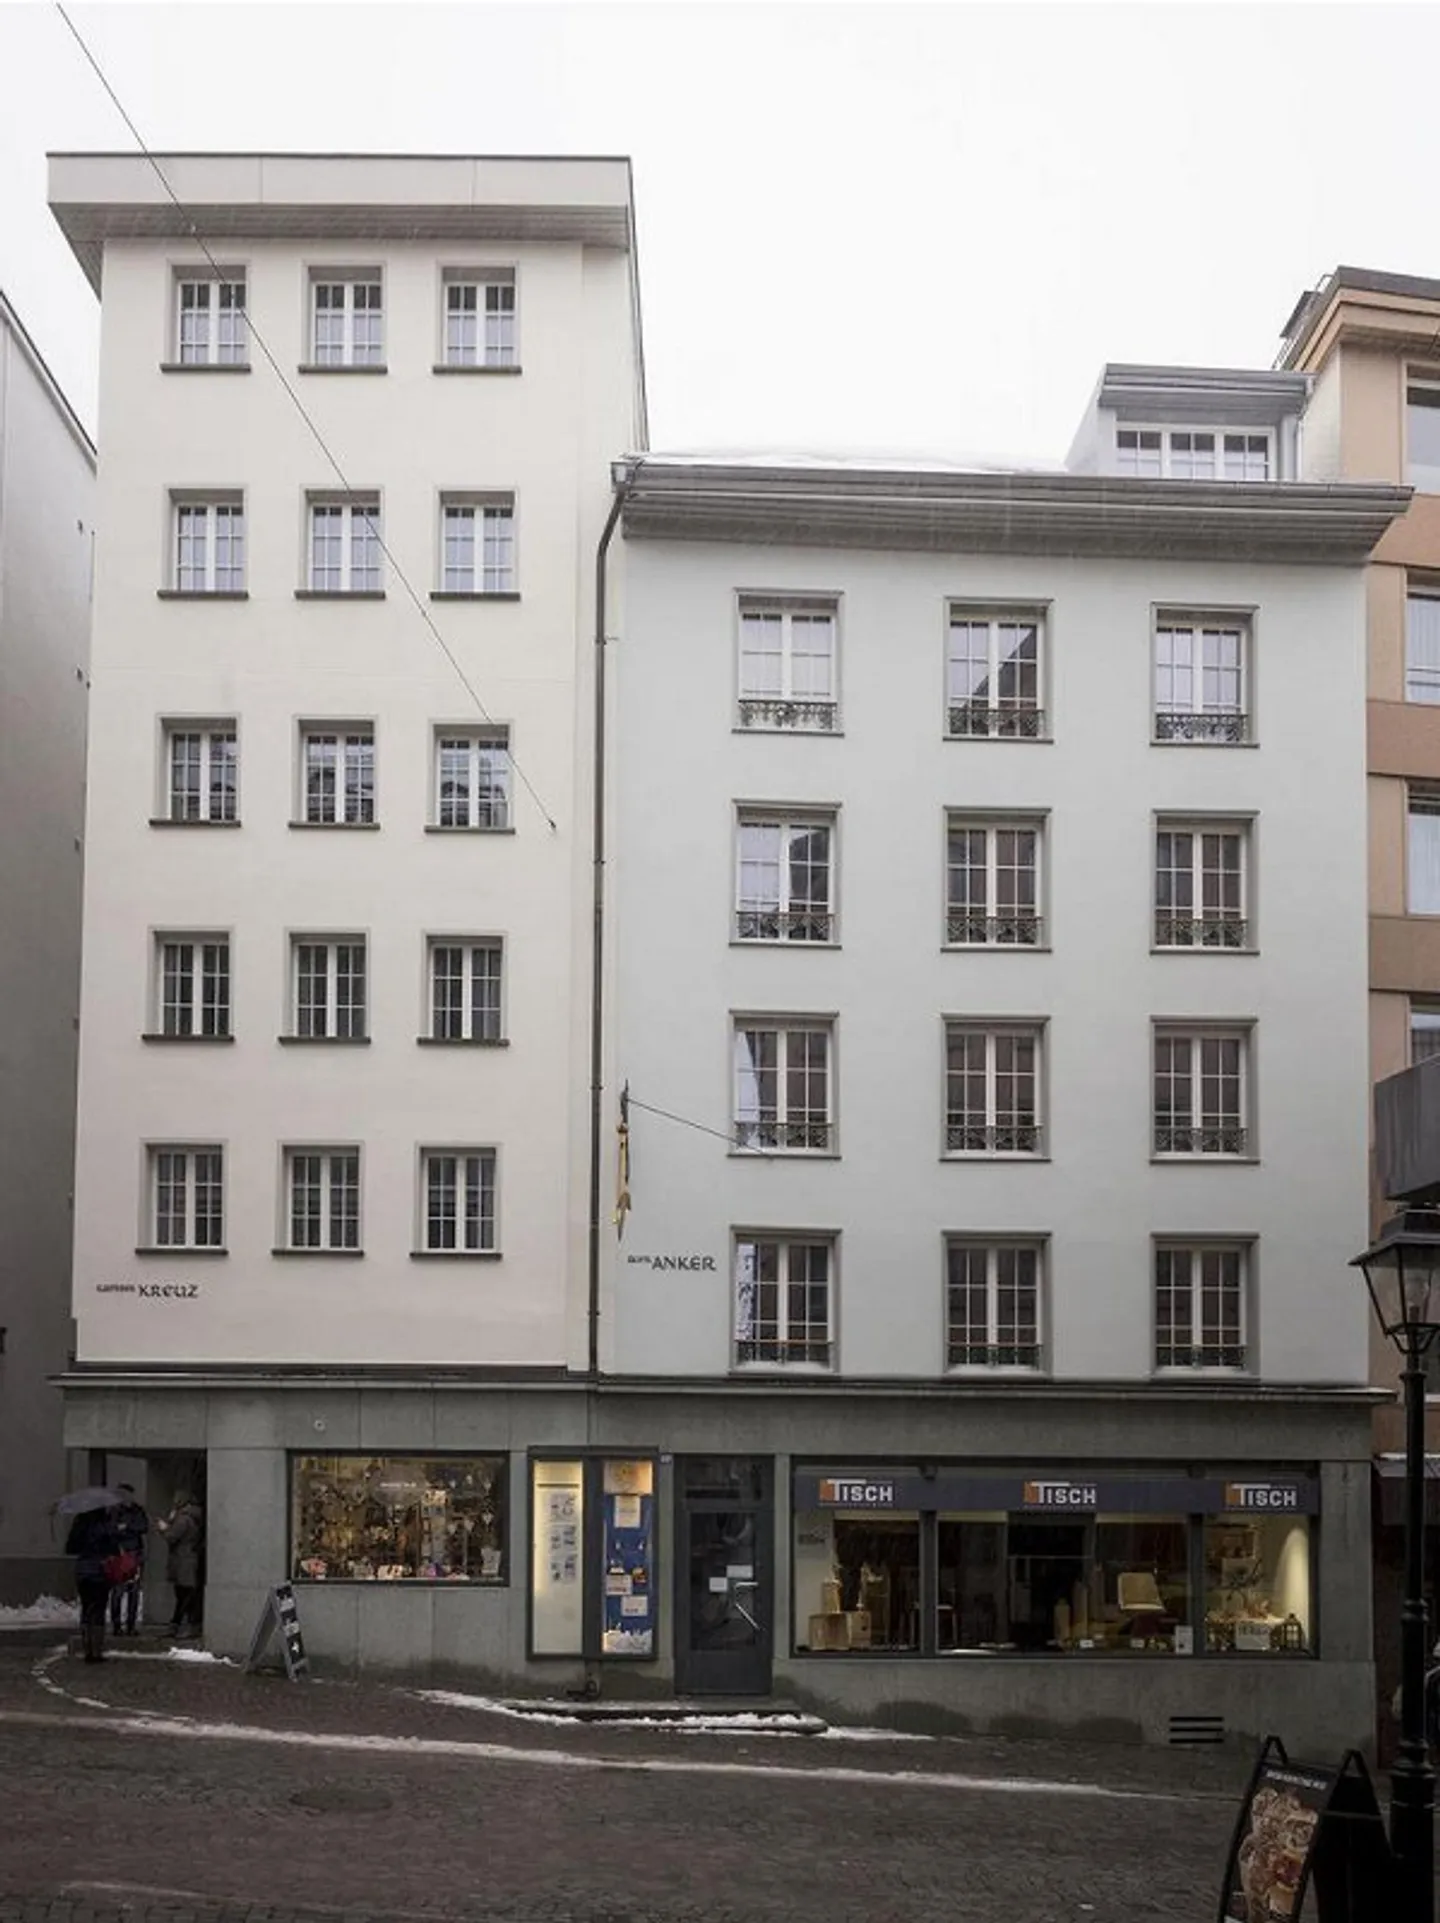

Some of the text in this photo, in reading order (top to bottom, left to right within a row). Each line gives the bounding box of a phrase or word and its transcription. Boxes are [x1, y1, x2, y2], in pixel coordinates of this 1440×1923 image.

[652, 1255, 717, 1271] ANKER
[138, 1284, 199, 1298] KREUZ
[827, 1478, 894, 1502] TISCH
[1031, 1481, 1097, 1504] TISCH
[1231, 1484, 1298, 1506] TISCH
